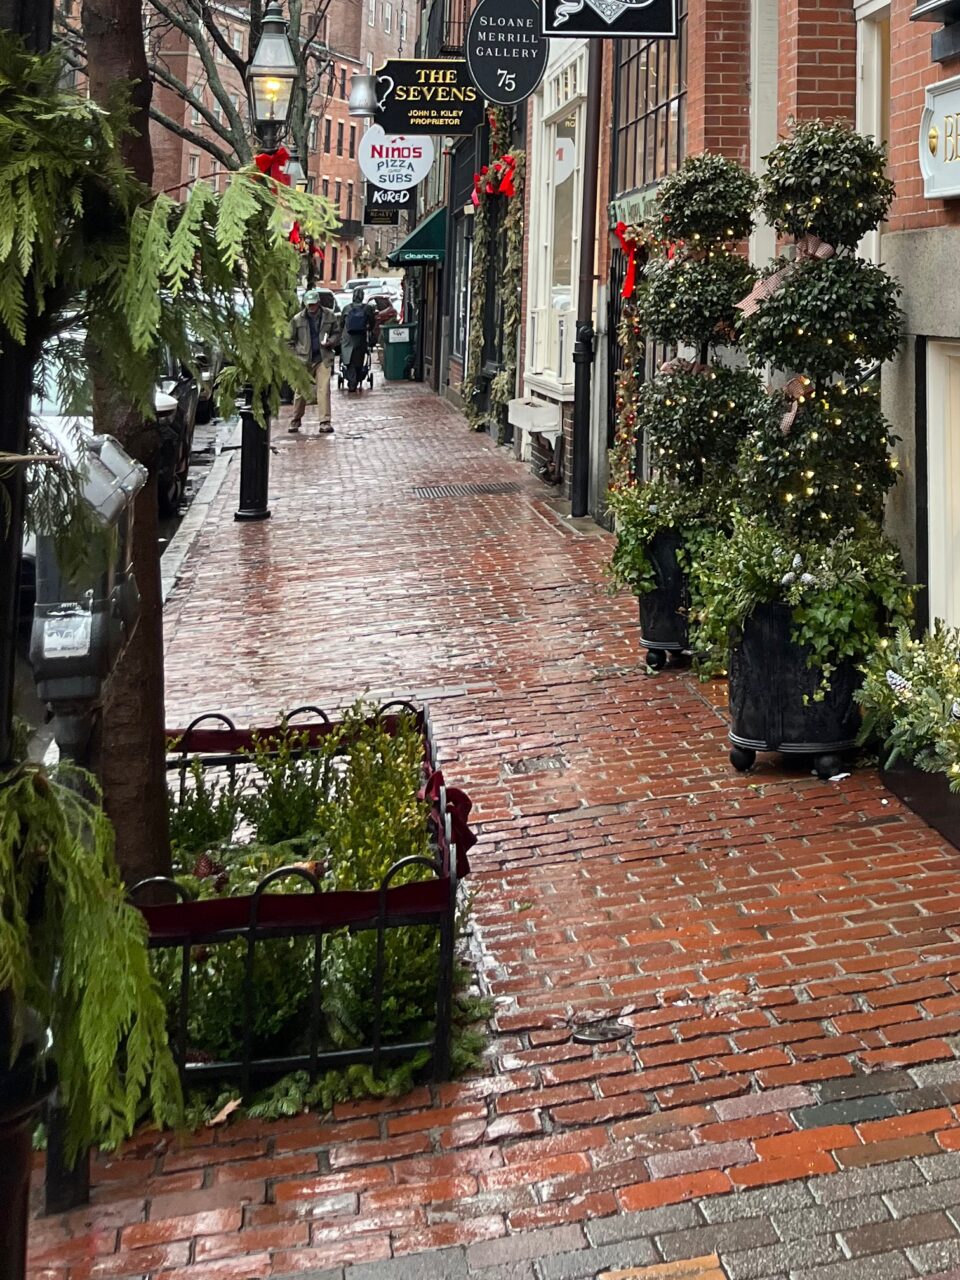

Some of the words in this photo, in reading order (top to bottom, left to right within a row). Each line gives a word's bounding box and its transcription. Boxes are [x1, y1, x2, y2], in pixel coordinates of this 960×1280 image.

[479, 16, 533, 28] SLOANE
[478, 31, 539, 43] MERRILL
[476, 47, 538, 58] GALLERY
[415, 69, 457, 83] THE
[496, 68, 516, 91] 75
[394, 85, 477, 101] SEVENS
[408, 109, 430, 117] JOHN
[440, 109, 463, 117] KILEY
[377, 160, 415, 172] PIZZA
[378, 173, 413, 183] SUBS
